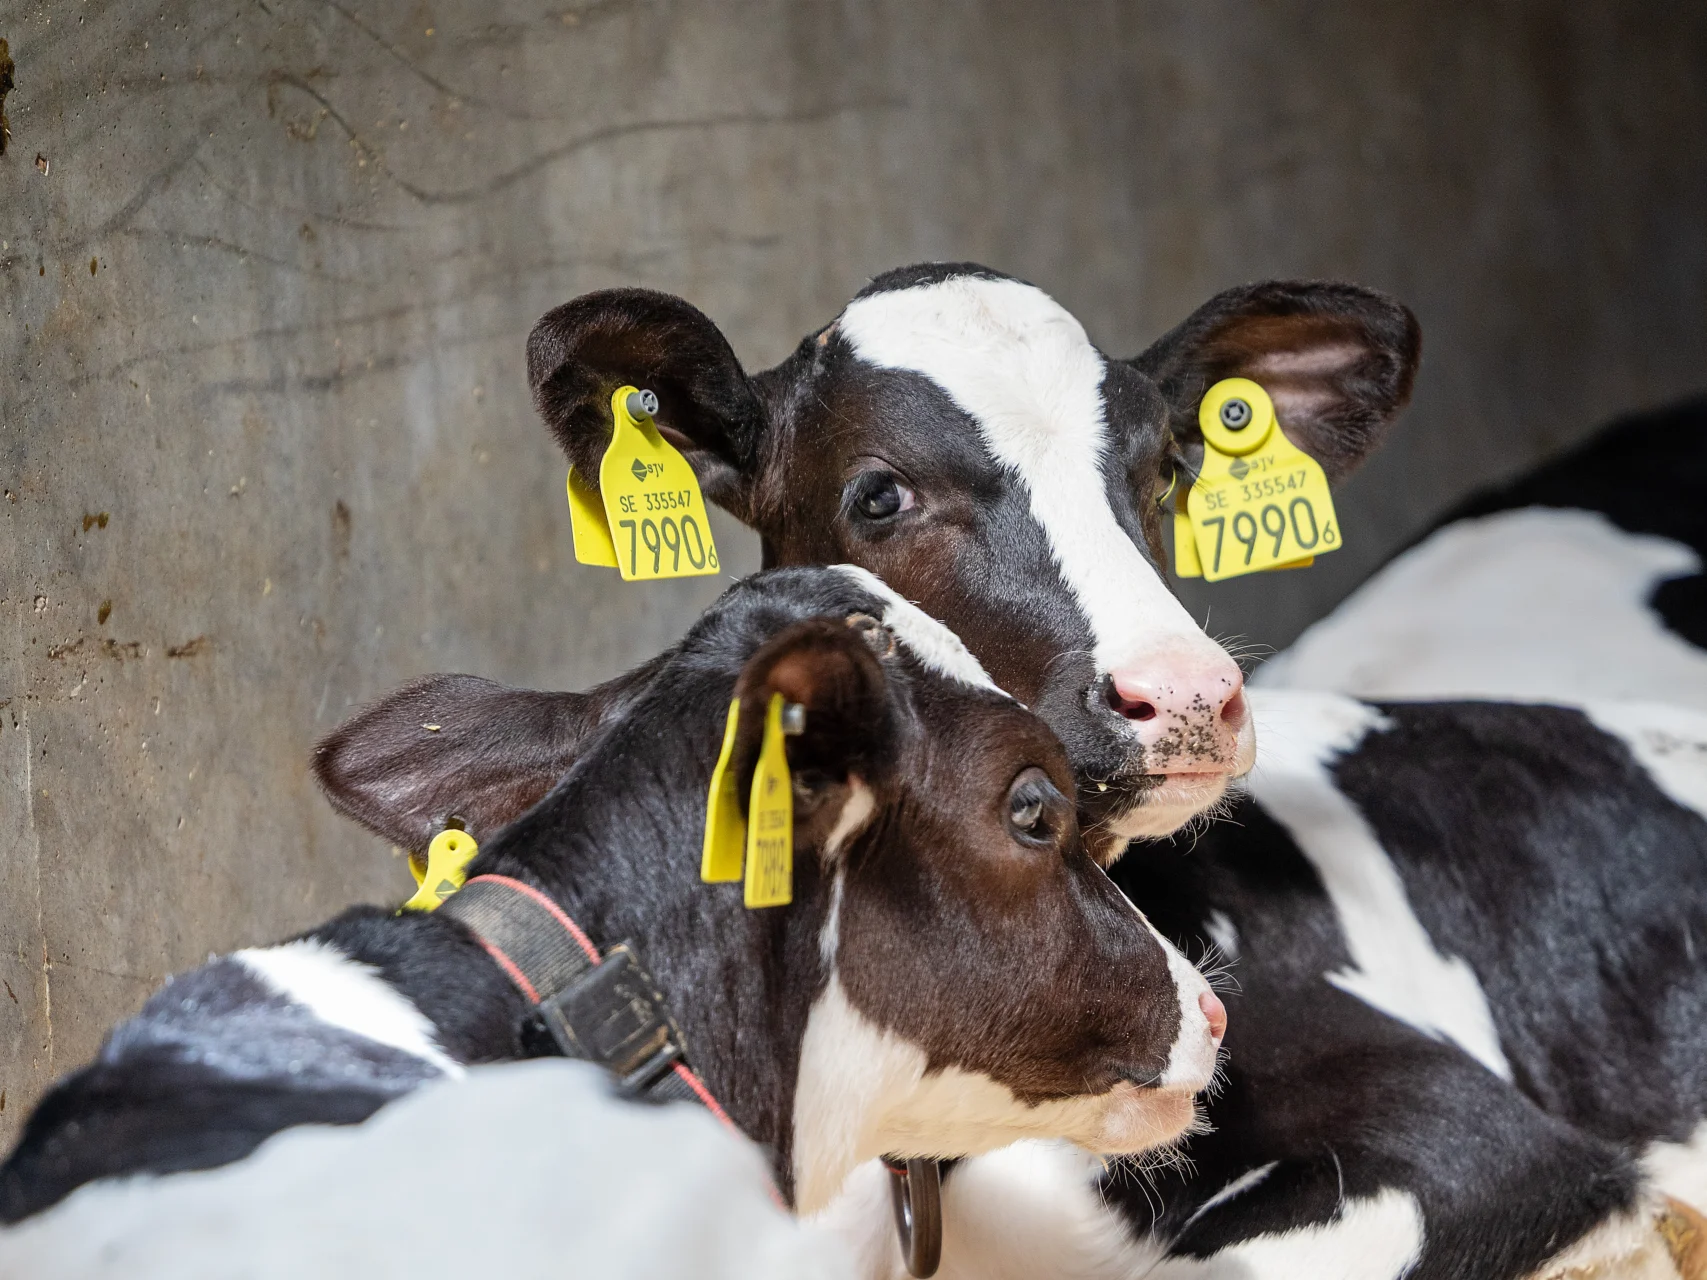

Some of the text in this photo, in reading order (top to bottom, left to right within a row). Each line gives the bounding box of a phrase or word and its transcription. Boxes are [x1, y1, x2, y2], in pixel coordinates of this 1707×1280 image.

[619, 490, 691, 513] SE 335547
[1204, 470, 1307, 511] SE 335547
